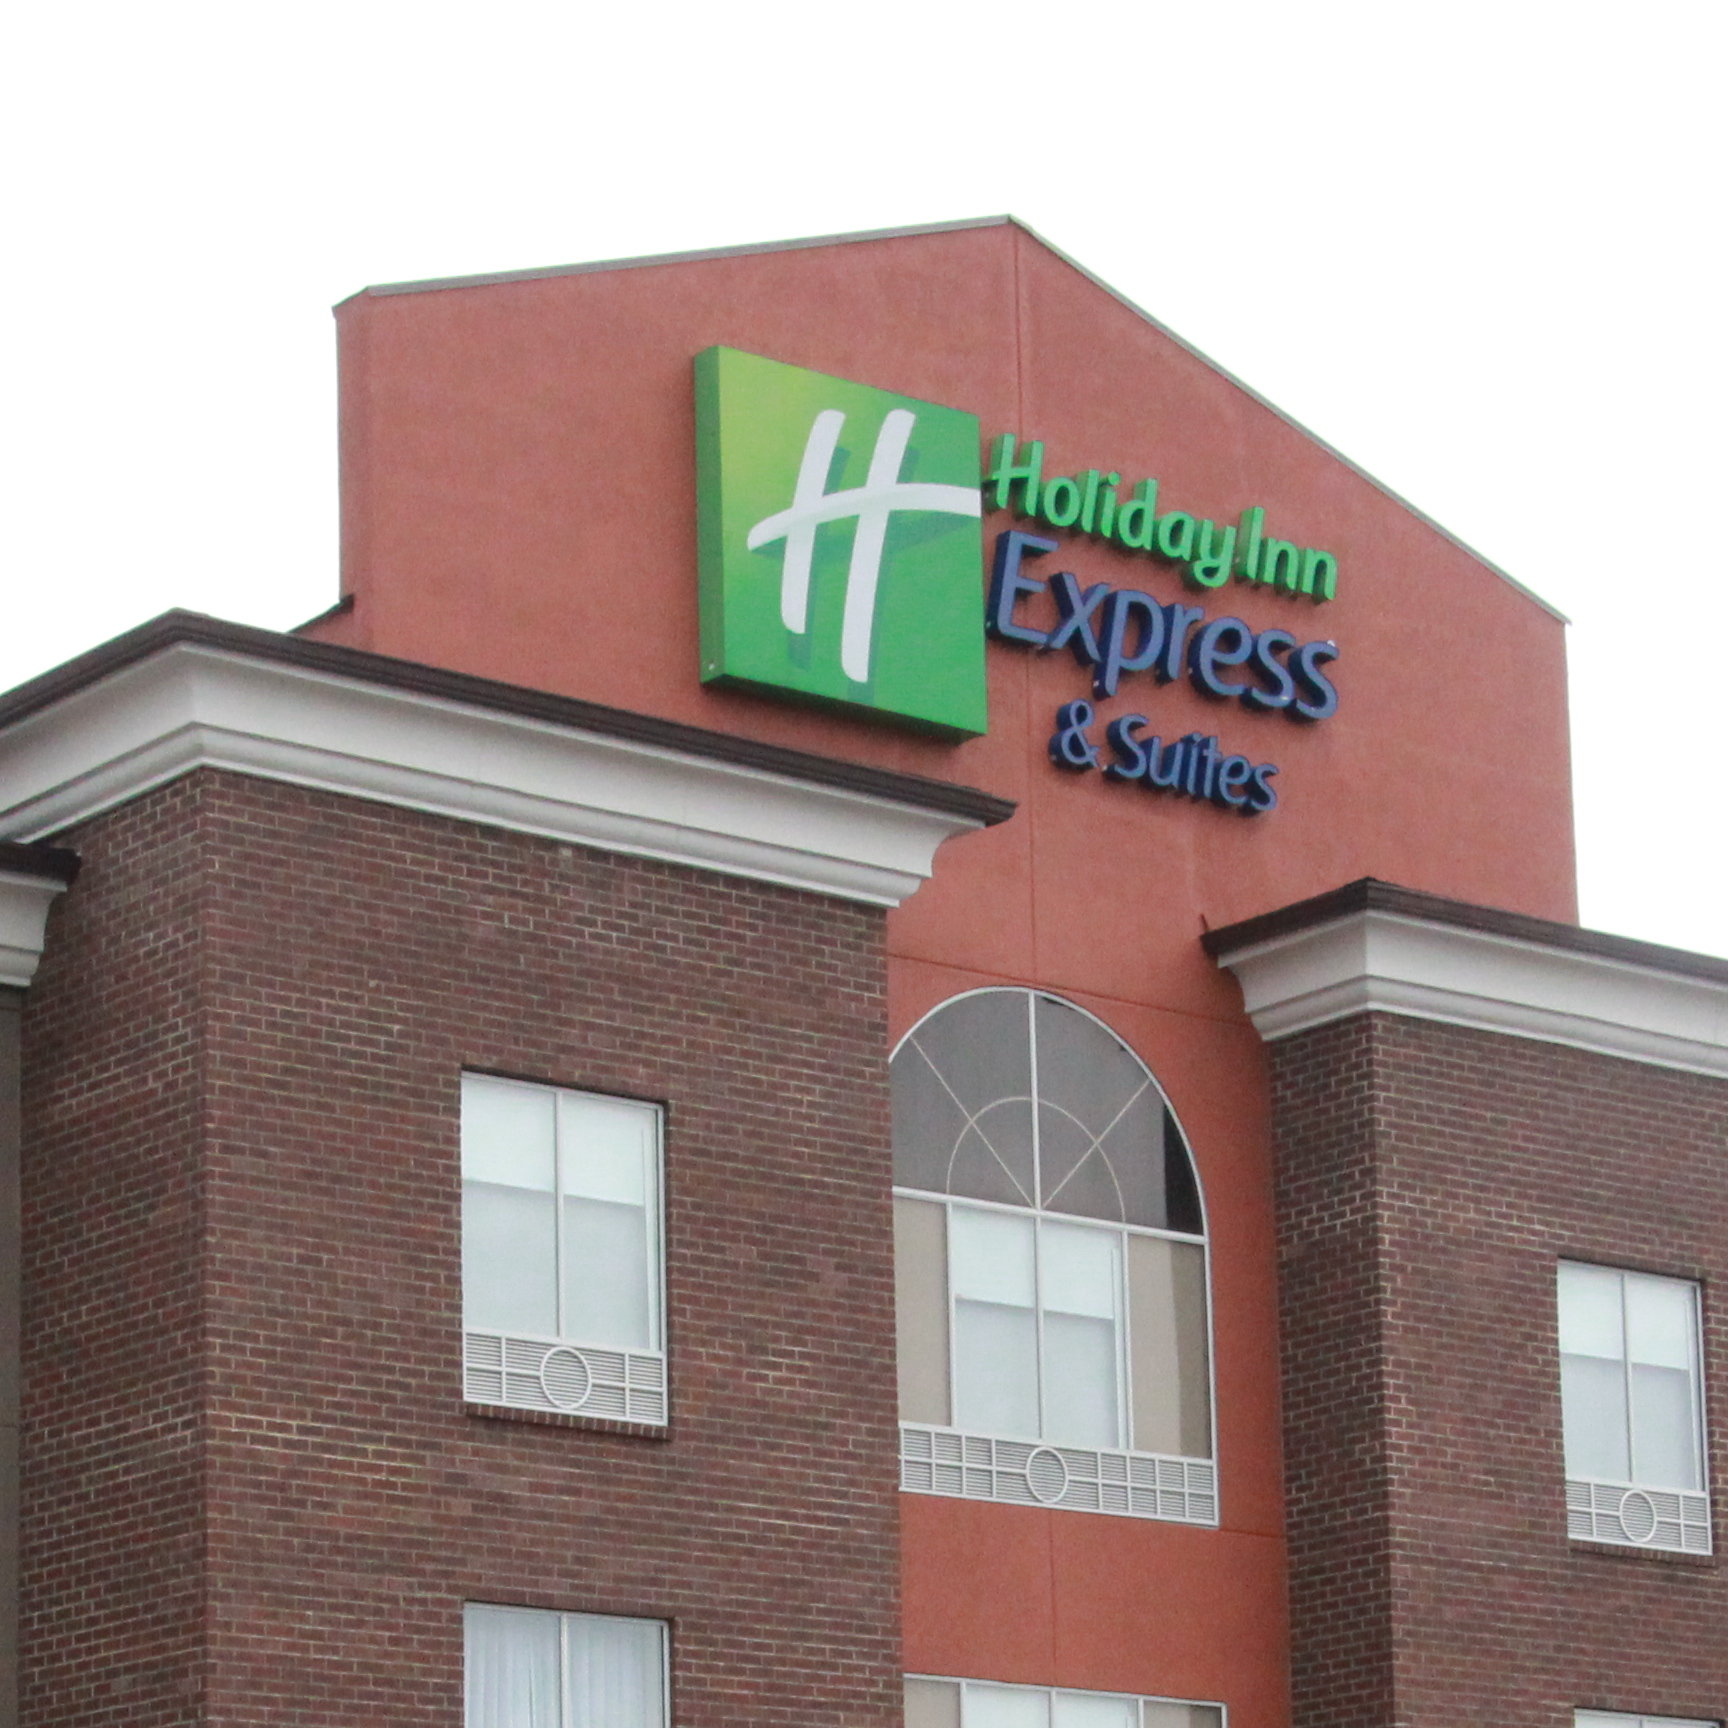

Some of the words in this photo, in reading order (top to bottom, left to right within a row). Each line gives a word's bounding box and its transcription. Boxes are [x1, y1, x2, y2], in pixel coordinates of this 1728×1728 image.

[983, 433, 1236, 588] Holiday
[1236, 505, 1337, 601] Inn
[986, 529, 1339, 721] Express
[1048, 699, 1098, 770] &
[1102, 712, 1278, 813] Suites
